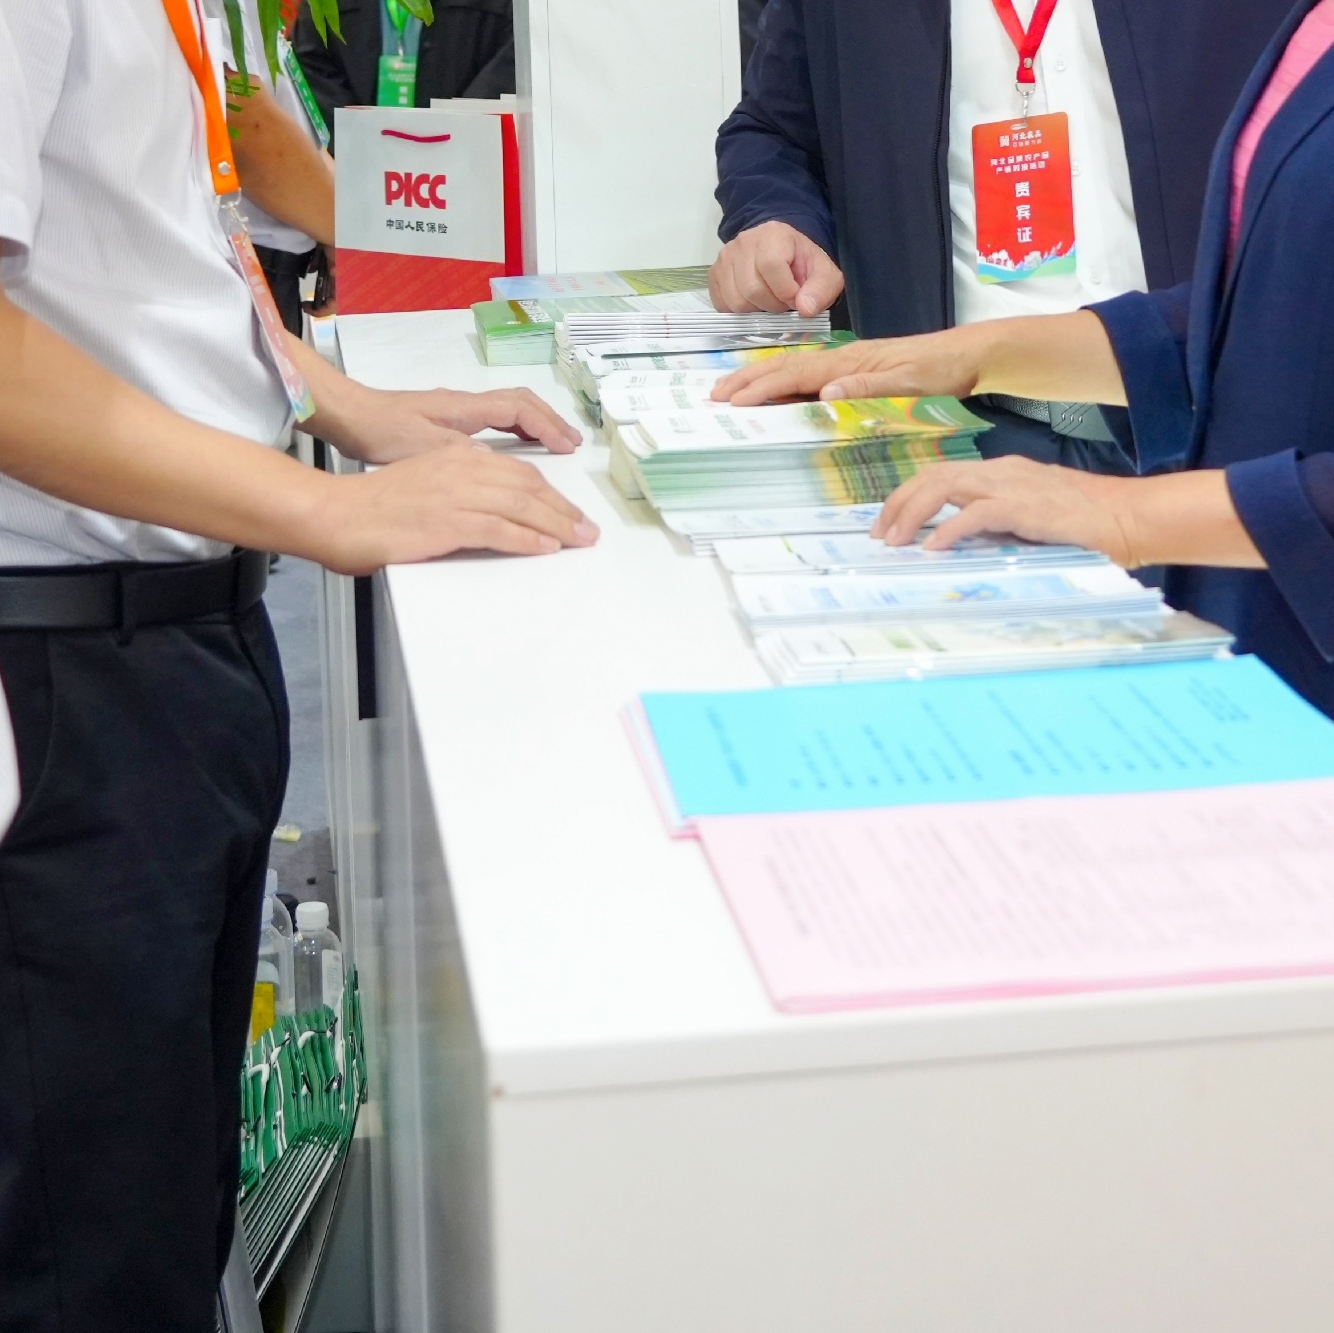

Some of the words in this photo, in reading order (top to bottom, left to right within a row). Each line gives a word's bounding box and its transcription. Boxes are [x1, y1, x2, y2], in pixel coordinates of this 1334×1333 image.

[384, 171, 446, 210] PICC
[386, 219, 448, 234] 中国人民保险
[1015, 182, 1033, 243] 贵宾证
